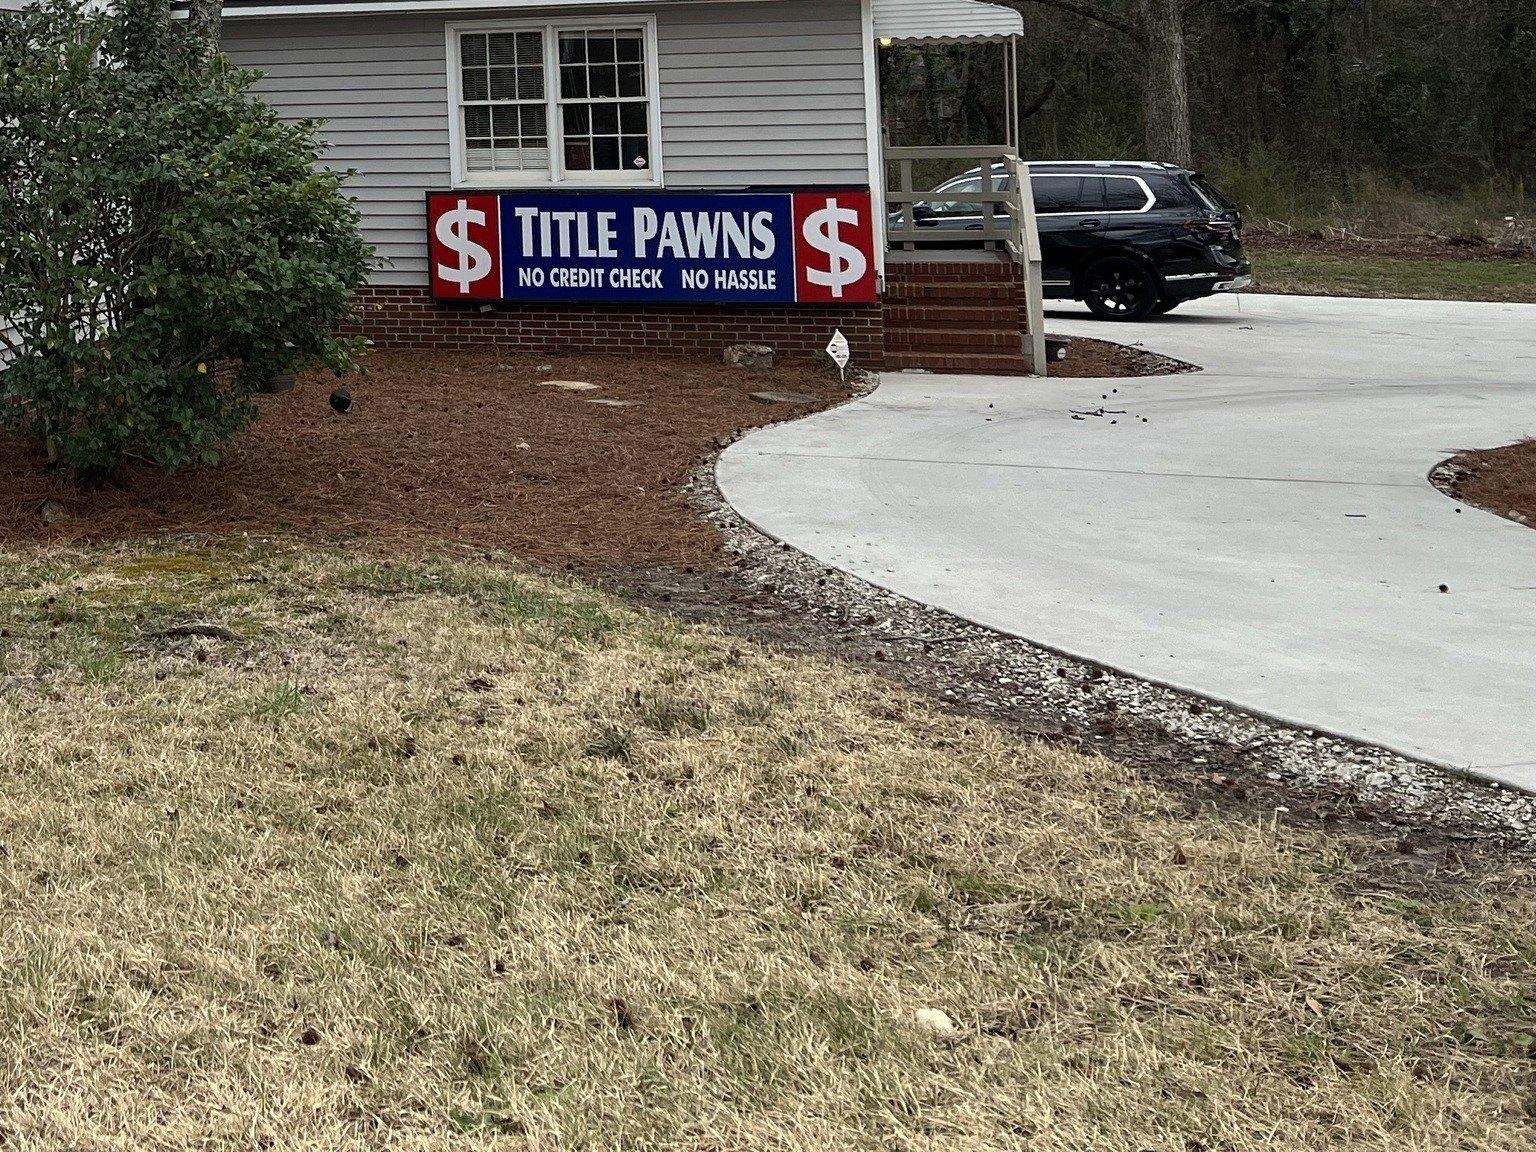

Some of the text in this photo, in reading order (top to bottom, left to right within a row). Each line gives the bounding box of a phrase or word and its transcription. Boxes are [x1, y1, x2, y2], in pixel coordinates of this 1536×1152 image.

[435, 200, 493, 293] $
[514, 206, 776, 260] TITLE PAWNS
[802, 198, 868, 298] $
[518, 267, 776, 291] NO CREDIT CHECK NO HASSLE
